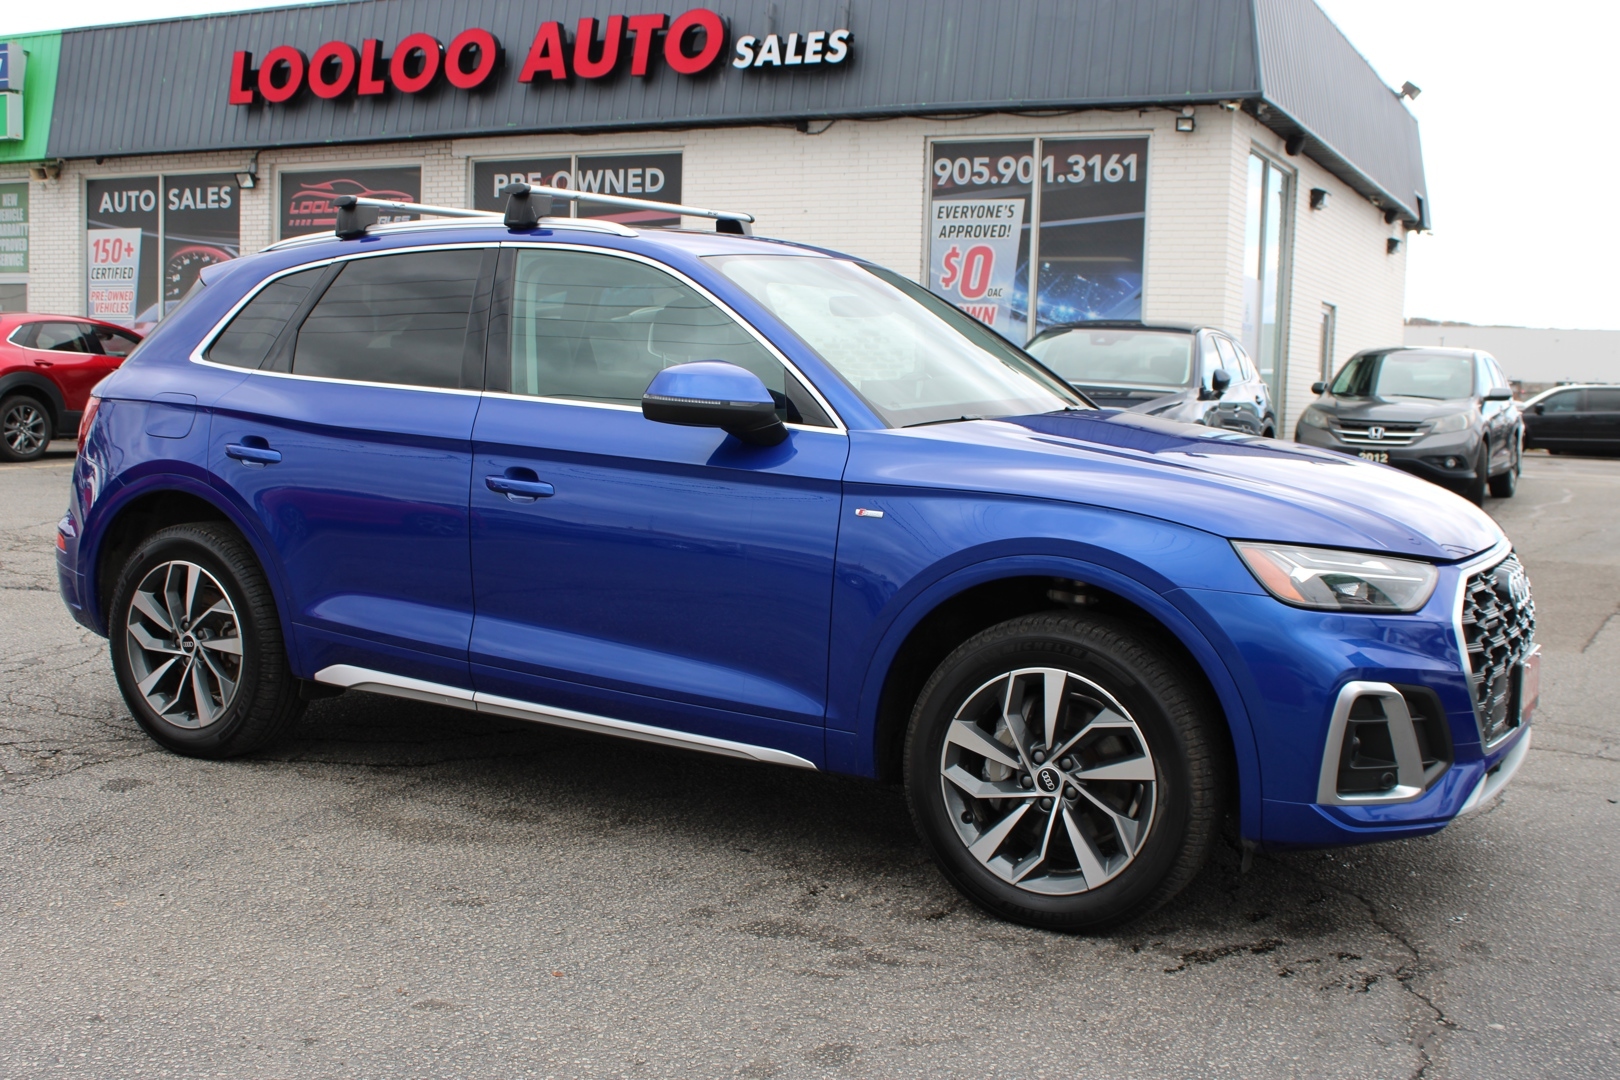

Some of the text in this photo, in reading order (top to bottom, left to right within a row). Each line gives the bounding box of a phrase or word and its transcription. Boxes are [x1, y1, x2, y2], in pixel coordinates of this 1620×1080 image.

[229, 8, 852, 105] LOOLOO AUTO SALES
[934, 154, 1138, 185] 905.901.3161
[2, 193, 18, 207] NEW
[99, 186, 232, 213] AUTO SALES
[289, 200, 340, 215] LOOL
[937, 204, 1015, 219] EVERYONE'S
[938, 224, 1012, 238] APPROVED!
[92, 237, 134, 264] 150+
[91, 267, 134, 280] CERTIFIED
[941, 246, 994, 299] $0
[90, 290, 134, 301] PRE-OWNED
[987, 288, 1003, 297] OAC
[94, 302, 129, 314] VEHICLES
[959, 306, 996, 325] WN
